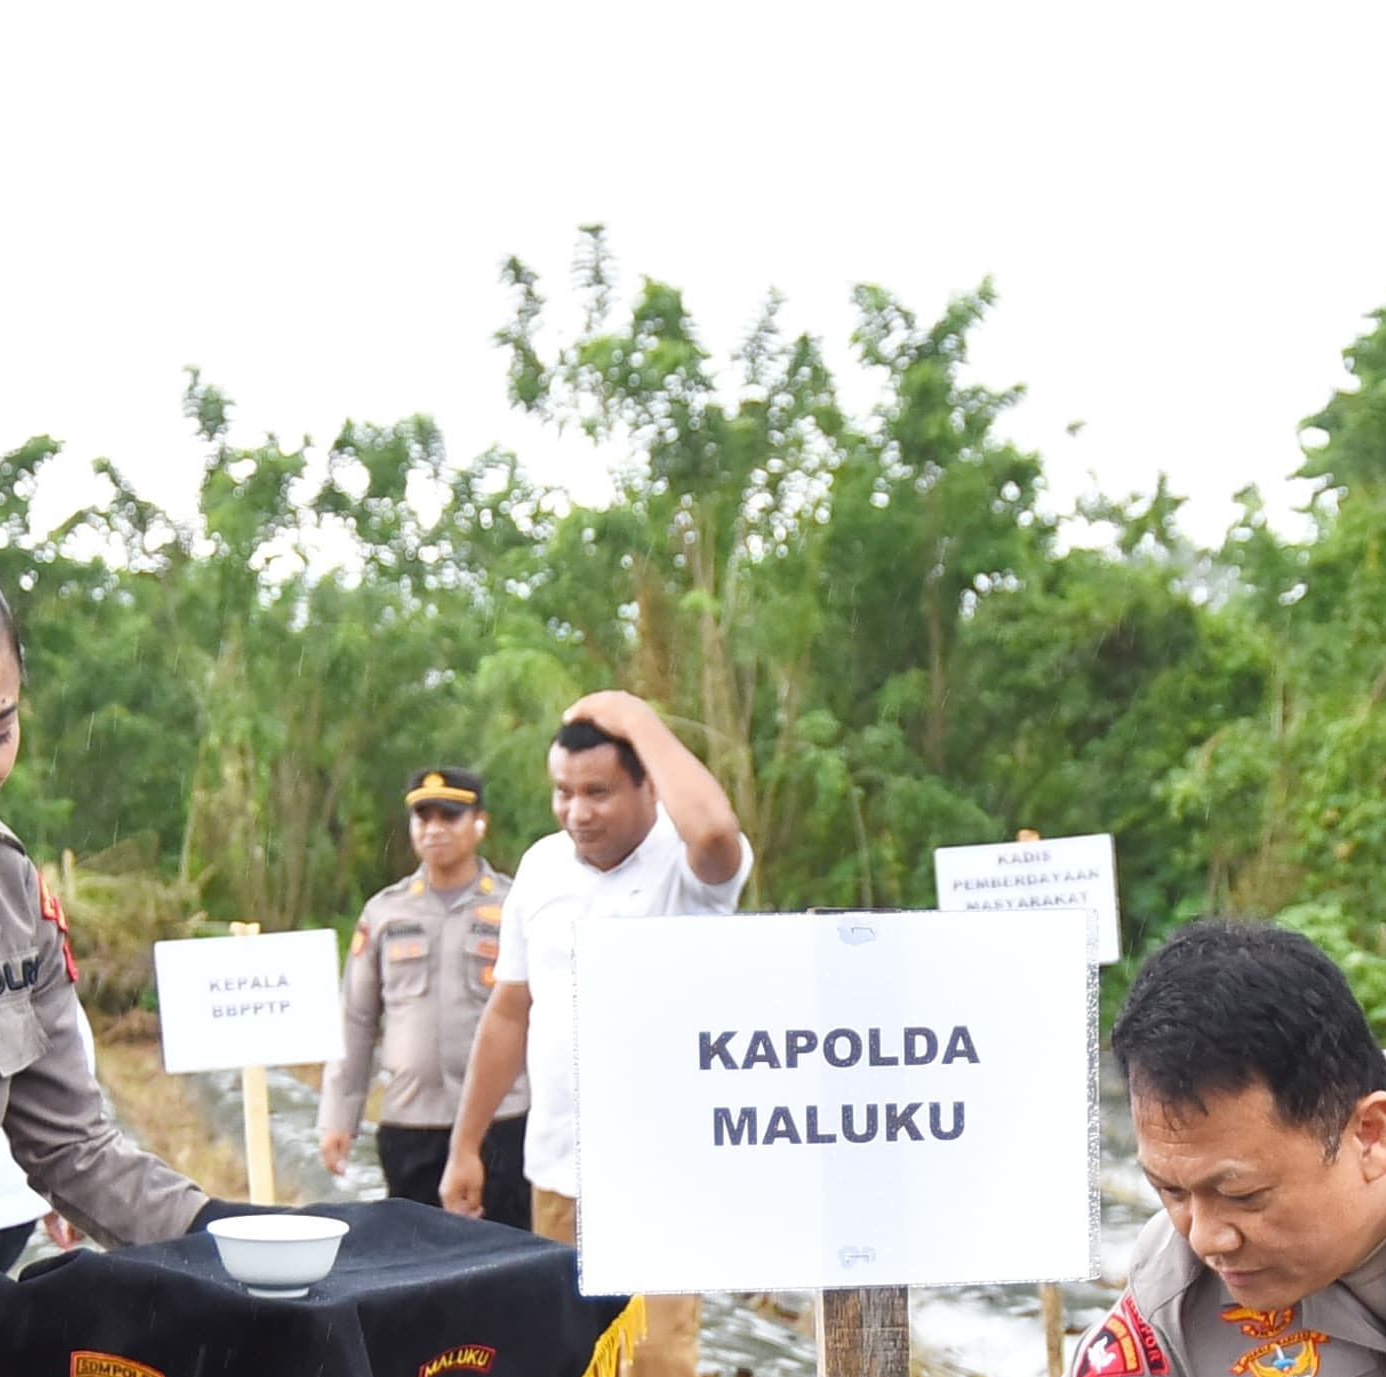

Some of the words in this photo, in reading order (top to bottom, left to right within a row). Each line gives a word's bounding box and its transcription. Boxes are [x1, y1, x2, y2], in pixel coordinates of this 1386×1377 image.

[997, 850, 1051, 865] KADIS
[209, 974, 290, 993] KEPALA
[699, 1026, 981, 1070] KAPOLDA
[713, 1101, 965, 1145] MALUKU
[81, 1359, 111, 1376] SDM
